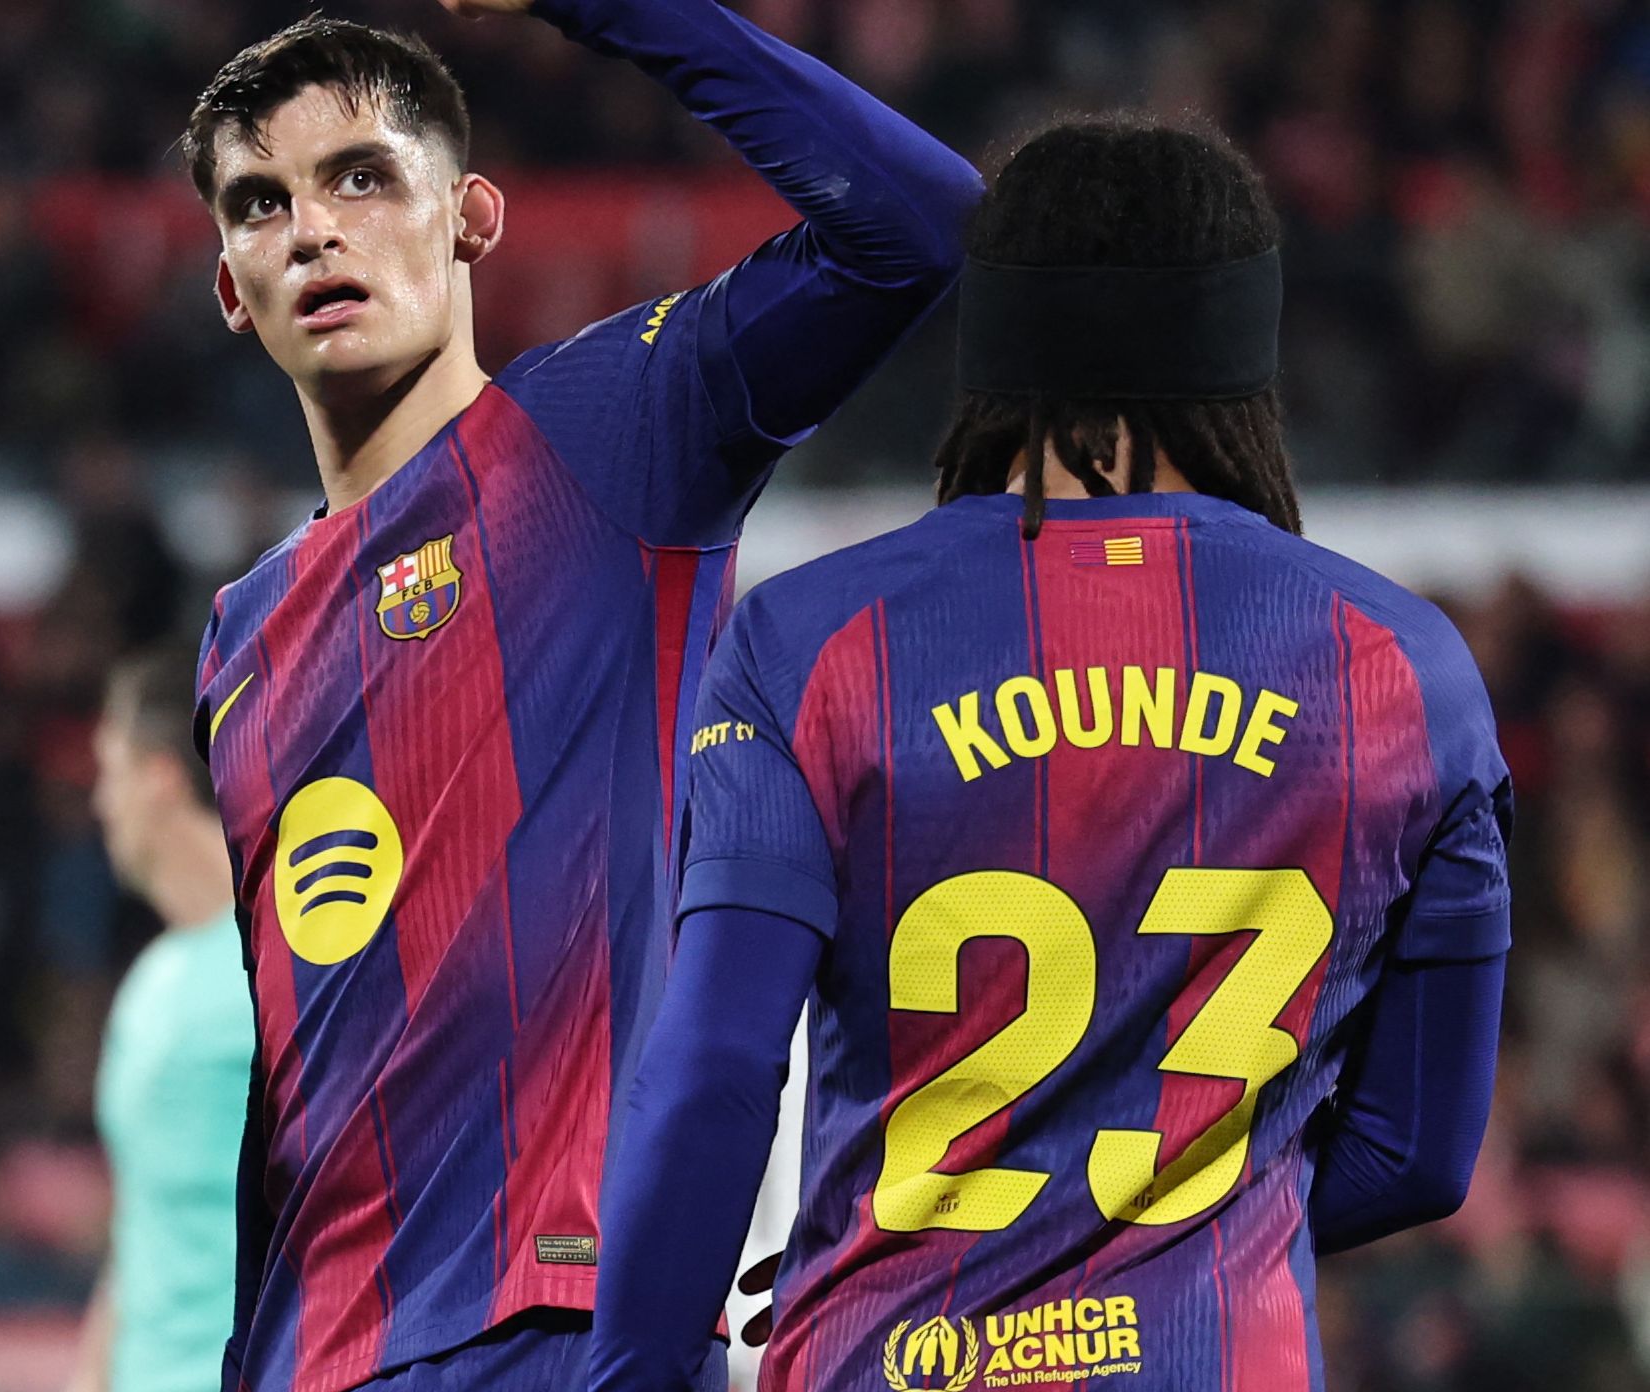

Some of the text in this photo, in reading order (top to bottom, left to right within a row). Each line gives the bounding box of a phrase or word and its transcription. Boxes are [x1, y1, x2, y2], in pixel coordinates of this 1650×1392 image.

[401, 579, 434, 601] FCB
[735, 720, 755, 742] tv
[930, 664, 1300, 782] KOUNDE
[871, 867, 1336, 1233] 23
[984, 1294, 1139, 1347] UNHCR
[983, 1327, 1142, 1377] ACNUR
[983, 1360, 1142, 1389] The UN Refugee Agency
